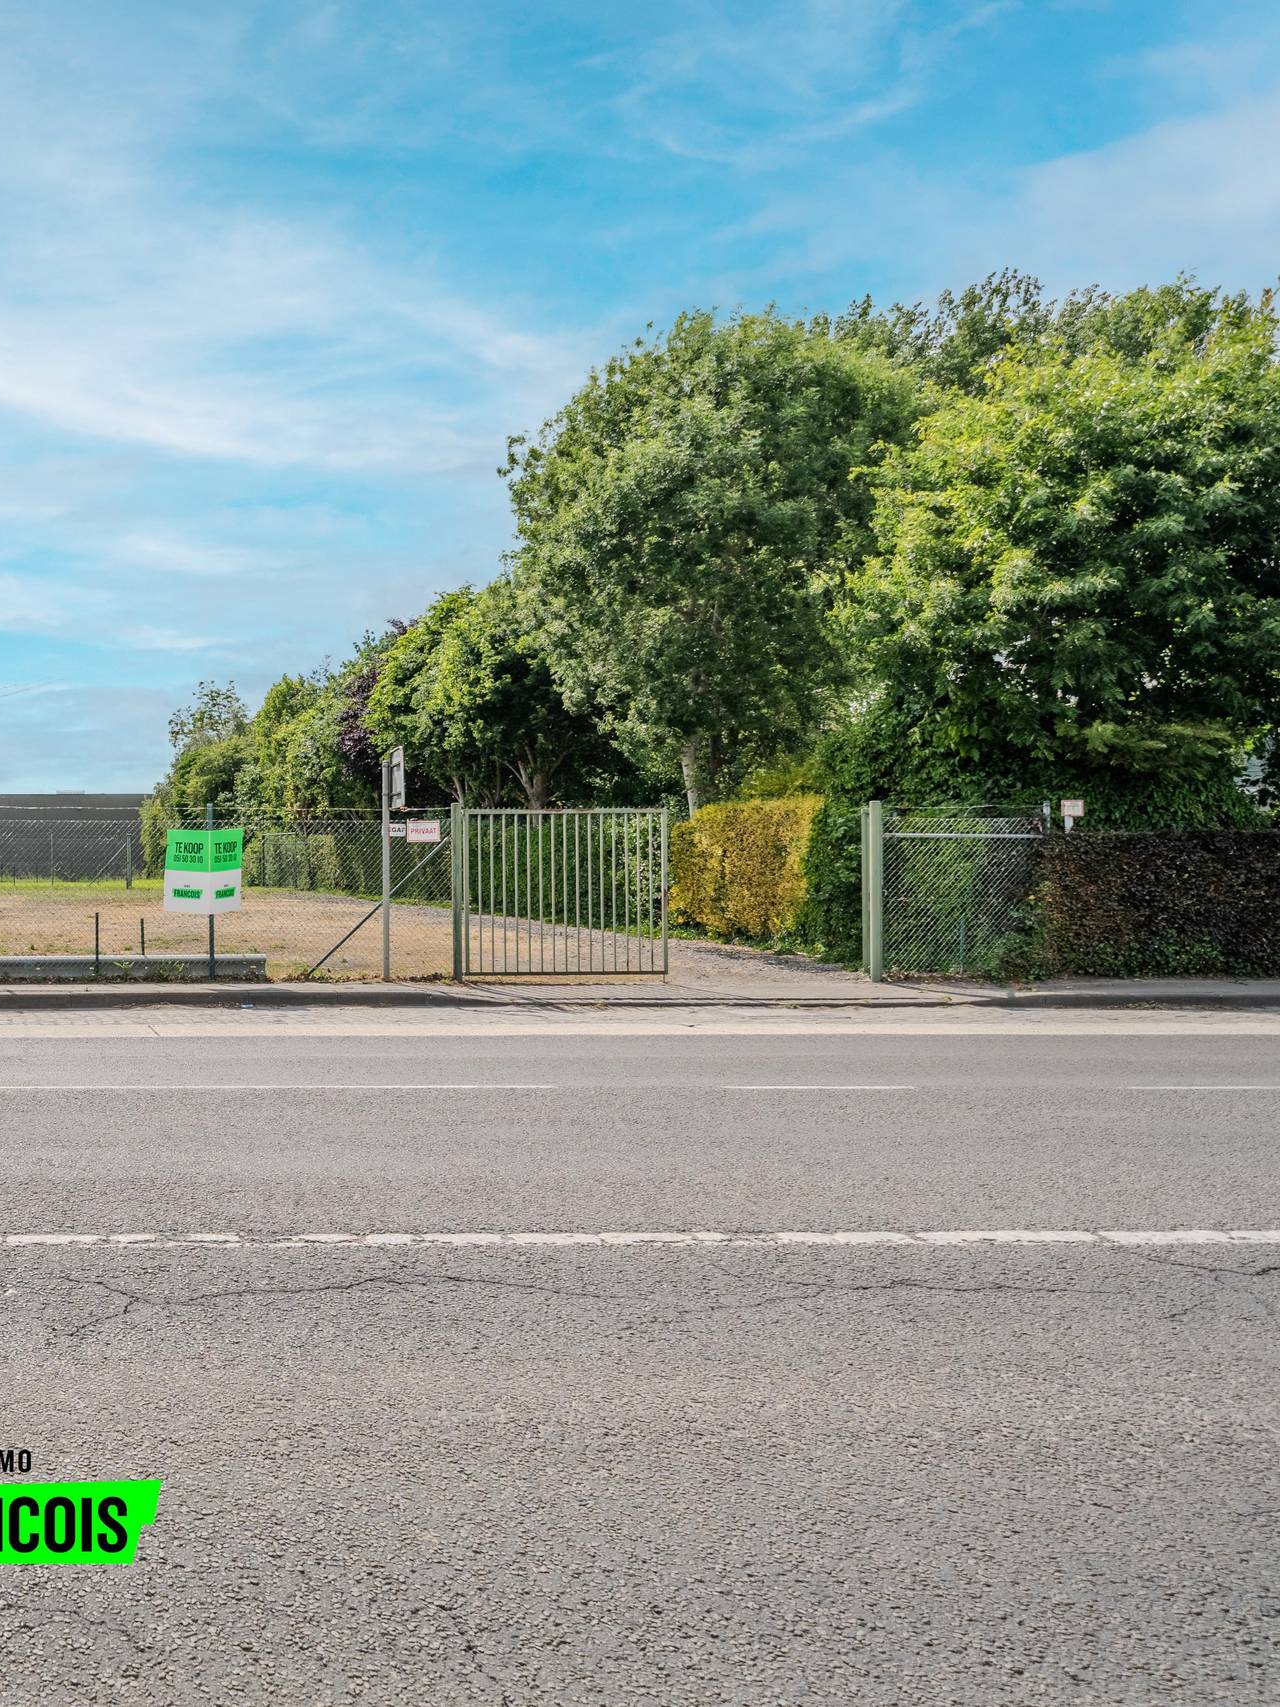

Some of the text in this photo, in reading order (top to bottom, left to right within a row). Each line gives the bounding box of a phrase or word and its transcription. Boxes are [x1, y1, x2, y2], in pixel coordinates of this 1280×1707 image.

[175, 842, 204, 854] TE KOOP
[214, 841, 237, 854] TE KOOP
